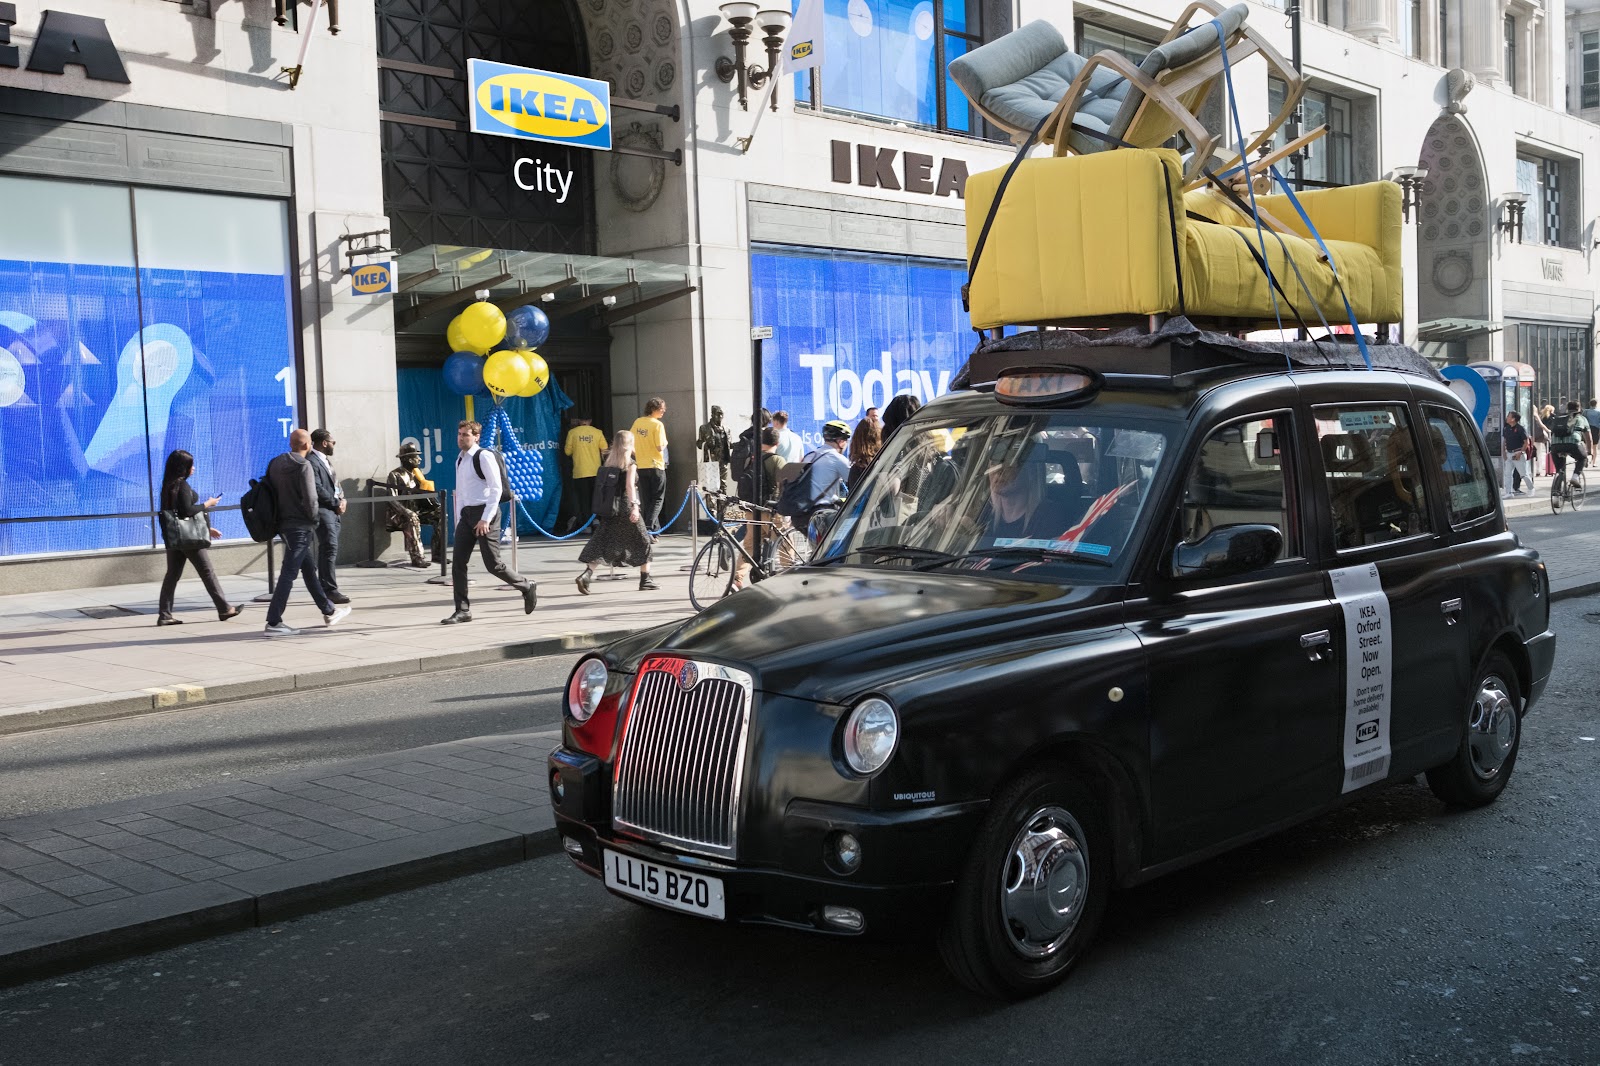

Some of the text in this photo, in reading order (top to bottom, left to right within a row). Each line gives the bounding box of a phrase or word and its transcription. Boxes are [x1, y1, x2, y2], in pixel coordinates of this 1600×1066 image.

[0, 2, 131, 84] A
[793, 45, 811, 55] IKEA
[490, 84, 598, 125] IKEA
[831, 139, 967, 199] IKEA
[514, 157, 573, 203] City
[355, 272, 387, 286] IKEA
[1008, 374, 1064, 393] TAXI
[579, 435, 594, 443] Hej!
[637, 428, 649, 437] Hej!
[1359, 605, 1377, 618] IKEA
[1357, 618, 1381, 633] Oxford
[1359, 634, 1382, 648] Street.
[1362, 650, 1379, 663] Now
[1361, 665, 1381, 681] Open.
[1358, 725, 1377, 738] IKEA
[893, 791, 936, 801] UBIQUITOUS
[615, 855, 659, 895] LL15
